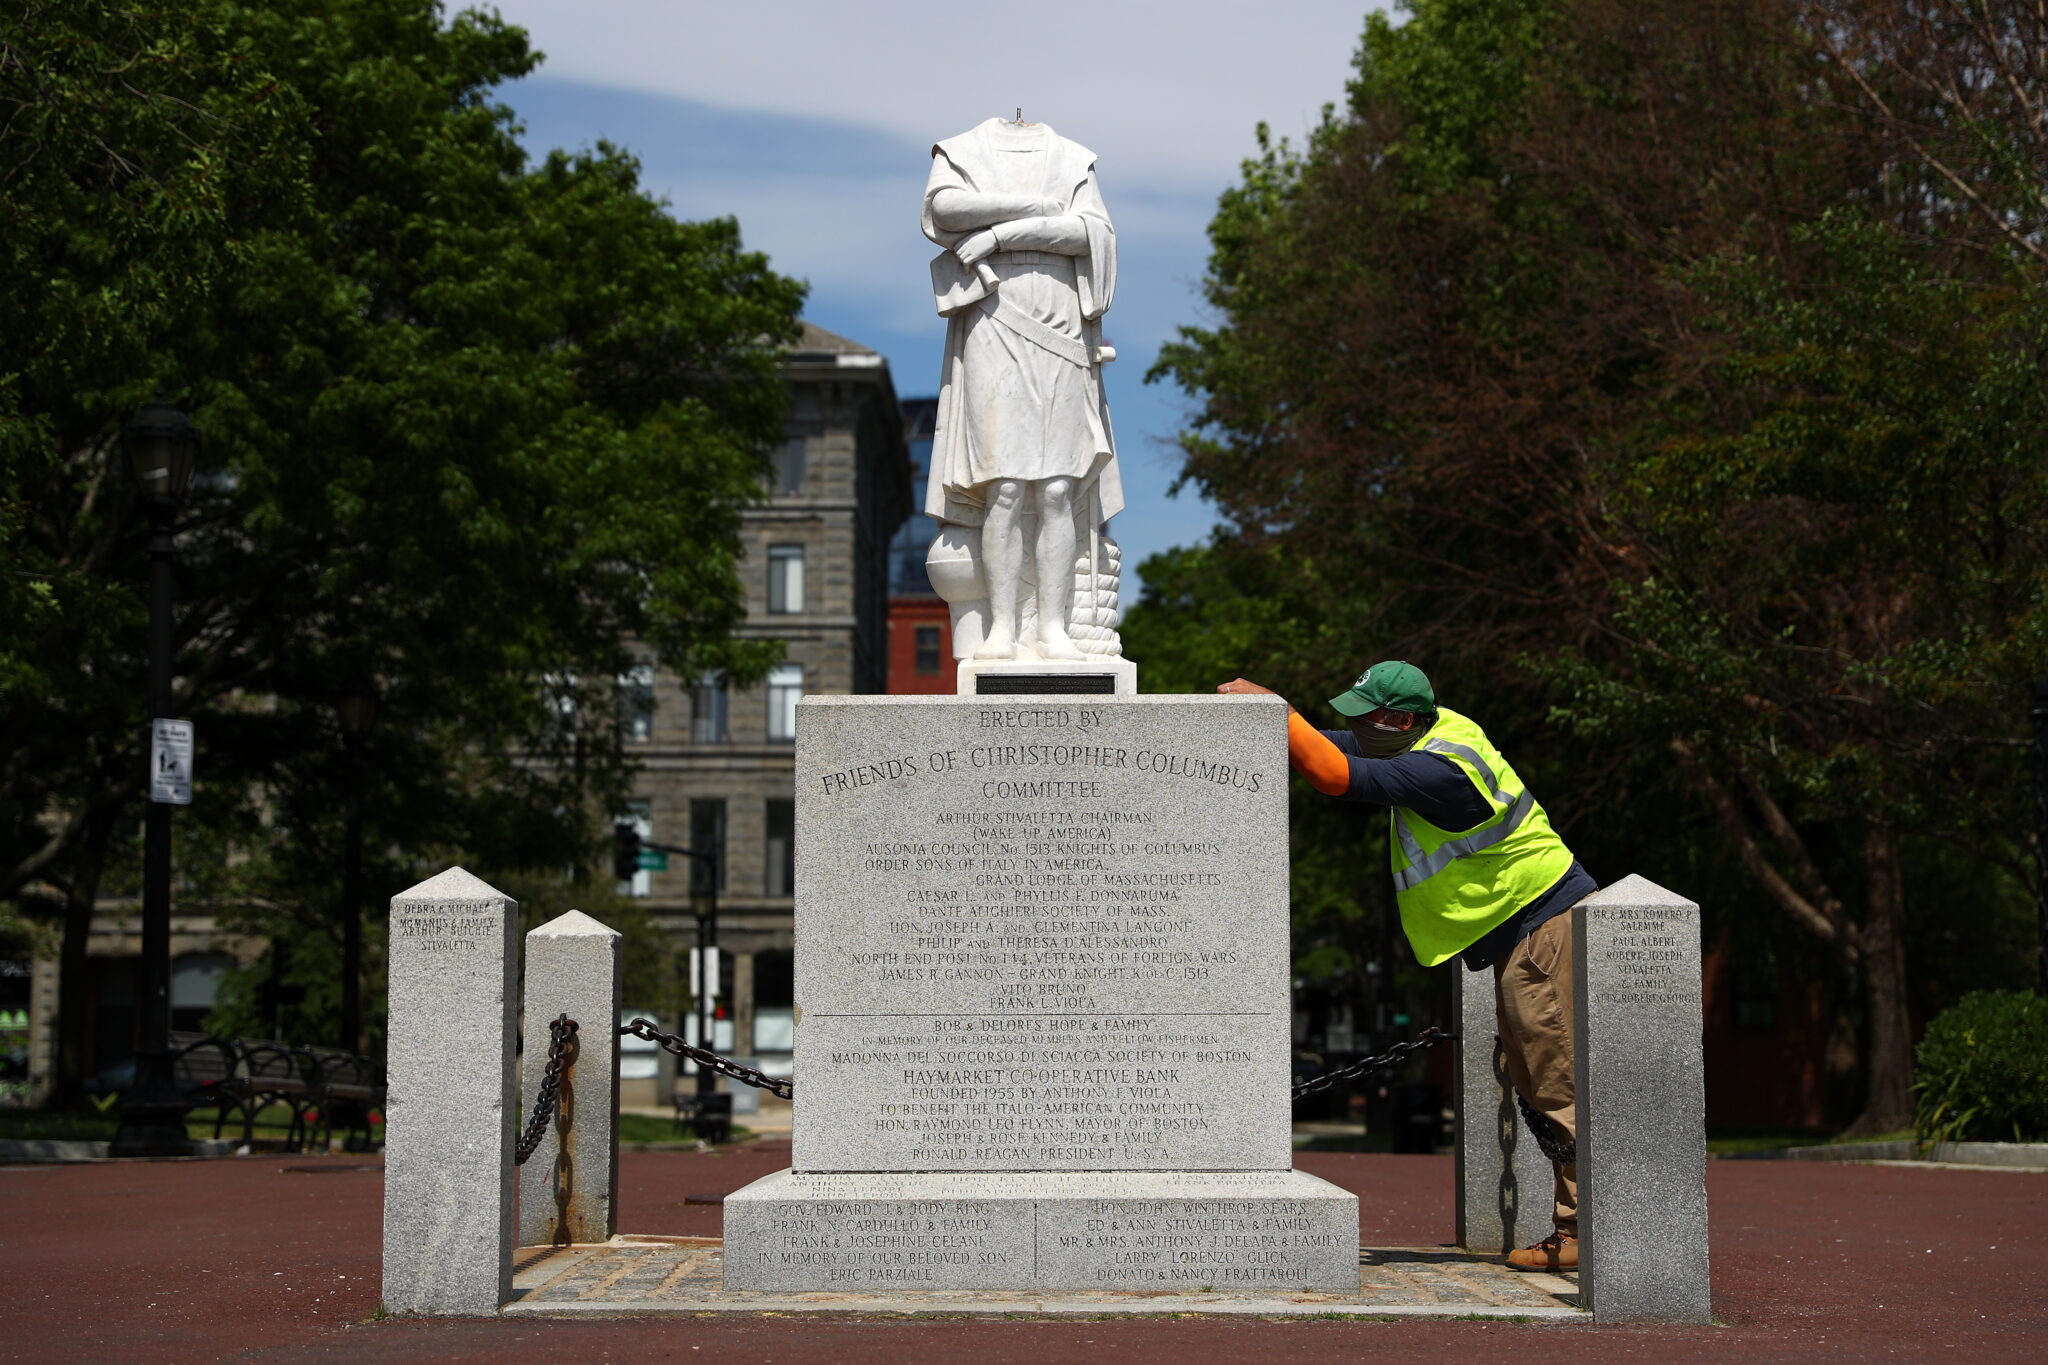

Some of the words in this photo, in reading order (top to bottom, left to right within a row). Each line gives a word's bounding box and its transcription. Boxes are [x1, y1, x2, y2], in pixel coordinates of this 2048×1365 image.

[980, 711, 1069, 728] ERECTED
[1080, 711, 1103, 728] BY
[822, 756, 918, 795] FRIENDS
[929, 750, 957, 773] OF
[971, 745, 1127, 768] CHRISTOPHER
[1136, 751, 1263, 793] COLUMBUS
[983, 782, 1102, 798] COMMITTEE
[936, 813, 989, 824] ARTHUR
[996, 813, 1073, 824] STIVALETTA
[1081, 813, 1152, 824] CHAIRMAN
[973, 827, 1014, 841] (WAKE
[1023, 828, 1041, 839] UP
[1047, 827, 1112, 841] AMERICA)
[865, 843, 926, 856] AUSONIA
[1026, 843, 1050, 856] 1513
[1057, 843, 1116, 856] KNIGHTS
[1121, 843, 1137, 856] OF
[1144, 843, 1220, 856] COLUMBUS
[865, 859, 910, 871] ORDER
[915, 859, 952, 871] SONS
[982, 859, 1017, 871] ITALY
[1025, 859, 1038, 871] IN
[976, 874, 1024, 886] GRAND
[1029, 874, 1073, 886] LODGE
[1080, 874, 1097, 886] OF
[1104, 874, 1221, 886] MASSACHUSETTS
[907, 890, 958, 902] CAESAR
[984, 893, 1006, 902] AND
[1015, 890, 1069, 902] PHYLLIS
[1091, 890, 1179, 902] DONNARUMA
[404, 905, 436, 914] DEBRA
[919, 906, 963, 917] DANTE
[969, 906, 1036, 917] ALIGHIERI
[1042, 906, 1100, 917] SOCIETY
[1106, 906, 1123, 917] OF
[1130, 906, 1171, 917] MASS.
[1644, 909, 1681, 920] ROMERO
[402, 927, 442, 936] ARTHUR
[928, 921, 979, 933] JOSEPH
[1004, 924, 1026, 933] AND
[1035, 921, 1119, 933] CLEMENTINA
[1126, 921, 1192, 933] LANGONE
[1621, 922, 1665, 931] SALEMME
[421, 941, 476, 950] STIVALETTA
[918, 937, 962, 949] PHILIP
[967, 940, 990, 949] AND
[998, 937, 1058, 949] THERESA
[852, 952, 897, 964] NORTH
[905, 952, 932, 964] END
[938, 952, 971, 964] POST
[1035, 952, 1105, 964] VETERANS
[1110, 952, 1127, 964] OF
[1134, 952, 1192, 964] FOREIGN
[1200, 952, 1237, 964] WARS
[1647, 951, 1682, 961] JOSEPH
[879, 968, 923, 980] JAMES
[945, 968, 1003, 980] GANNON
[1019, 968, 1067, 980] GRAND
[1184, 968, 1209, 980] 1513
[1618, 966, 1672, 975] STIVALETTA
[1001, 984, 1032, 995] VITO
[1039, 984, 1086, 995] BRUNO
[990, 997, 1035, 1009] FRANK
[1055, 997, 1096, 1009] VIOLA
[934, 1019, 961, 1031] BOB
[982, 1019, 1042, 1031] DELORES
[1050, 1019, 1086, 1031] HOPE
[1105, 1019, 1151, 1031] FAMILY
[878, 1035, 922, 1045] MEMORY
[945, 1035, 968, 1045] OUR
[1032, 1035, 1081, 1045] MEMBERS
[1086, 1035, 1108, 1045] AND
[1159, 1035, 1218, 1045] FISHERMEN
[831, 1051, 899, 1064] MADONNA
[907, 1051, 935, 1064] DEL
[939, 1051, 1014, 1064] SOCCORSO
[1042, 1051, 1100, 1064] SCIACCA
[1108, 1051, 1165, 1064] SOCIETY
[1171, 1051, 1189, 1064] OF
[1197, 1051, 1251, 1064] BOSTON
[904, 1070, 1005, 1084] HAYMARKET
[1010, 1070, 1130, 1084] CO-OPERATIVE
[1136, 1070, 1180, 1084] BANK
[912, 1087, 978, 1099] FOUNDED
[984, 1087, 1014, 1099] 1955
[1021, 1087, 1037, 1099] BY
[1043, 1087, 1108, 1099] ANTHONY
[1130, 1087, 1171, 1099] VIOLA
[880, 1103, 896, 1115] TO
[903, 1103, 955, 1115] BENEFIT
[965, 1103, 989, 1115] THE
[996, 1103, 1113, 1115] ITALO-AMERICAN
[1119, 1103, 1205, 1115] COMMUNITY
[913, 1119, 981, 1131] RAYMOND
[988, 1119, 1014, 1131] LEO
[1075, 1119, 1121, 1131] MAYOR
[1154, 1119, 1209, 1131] BOSTON
[919, 1132, 972, 1144] JOSEPH
[990, 1132, 1025, 1144] ROSE
[1033, 1132, 1096, 1144] KENNEDY
[1115, 1132, 1162, 1144] FAMILY
[912, 1148, 968, 1160] RONALD
[976, 1148, 1031, 1160] REAGAN
[1040, 1148, 1114, 1160] PRESIDENT
[816, 1203, 872, 1216] EDWARD
[909, 1203, 946, 1216] JODY
[955, 1203, 990, 1216] KING
[1134, 1202, 1174, 1215] JOHN
[1182, 1202, 1254, 1215] WINTHROP
[1262, 1202, 1307, 1215] SEARS
[773, 1219, 817, 1231] FRANK
[846, 1219, 919, 1231] CARDULLO
[943, 1219, 991, 1231] FAMILY
[1087, 1219, 1105, 1231] ED
[1126, 1219, 1156, 1231] ANN
[1165, 1219, 1245, 1231] STIVALETTA
[1265, 1219, 1315, 1231] FAMILY
[784, 1236, 828, 1248] FRANK
[850, 1236, 924, 1248] JOSEPHINE
[1135, 1235, 1201, 1248] ANTHONY
[1225, 1235, 1278, 1248] DELAPA
[1294, 1235, 1342, 1248] FAMILY
[781, 1252, 838, 1264] MEMORY
[847, 1252, 865, 1264] OF
[872, 1252, 901, 1264] OUR
[909, 1252, 970, 1264] BELOVED
[978, 1252, 1007, 1264] SON
[1115, 1251, 1160, 1264] LARRY
[1247, 1251, 1289, 1264] GLICK
[830, 1269, 861, 1281] ERIC
[869, 1269, 933, 1281] PARZIALE
[1097, 1268, 1155, 1281] DONATO
[1171, 1268, 1218, 1281] NANCY
